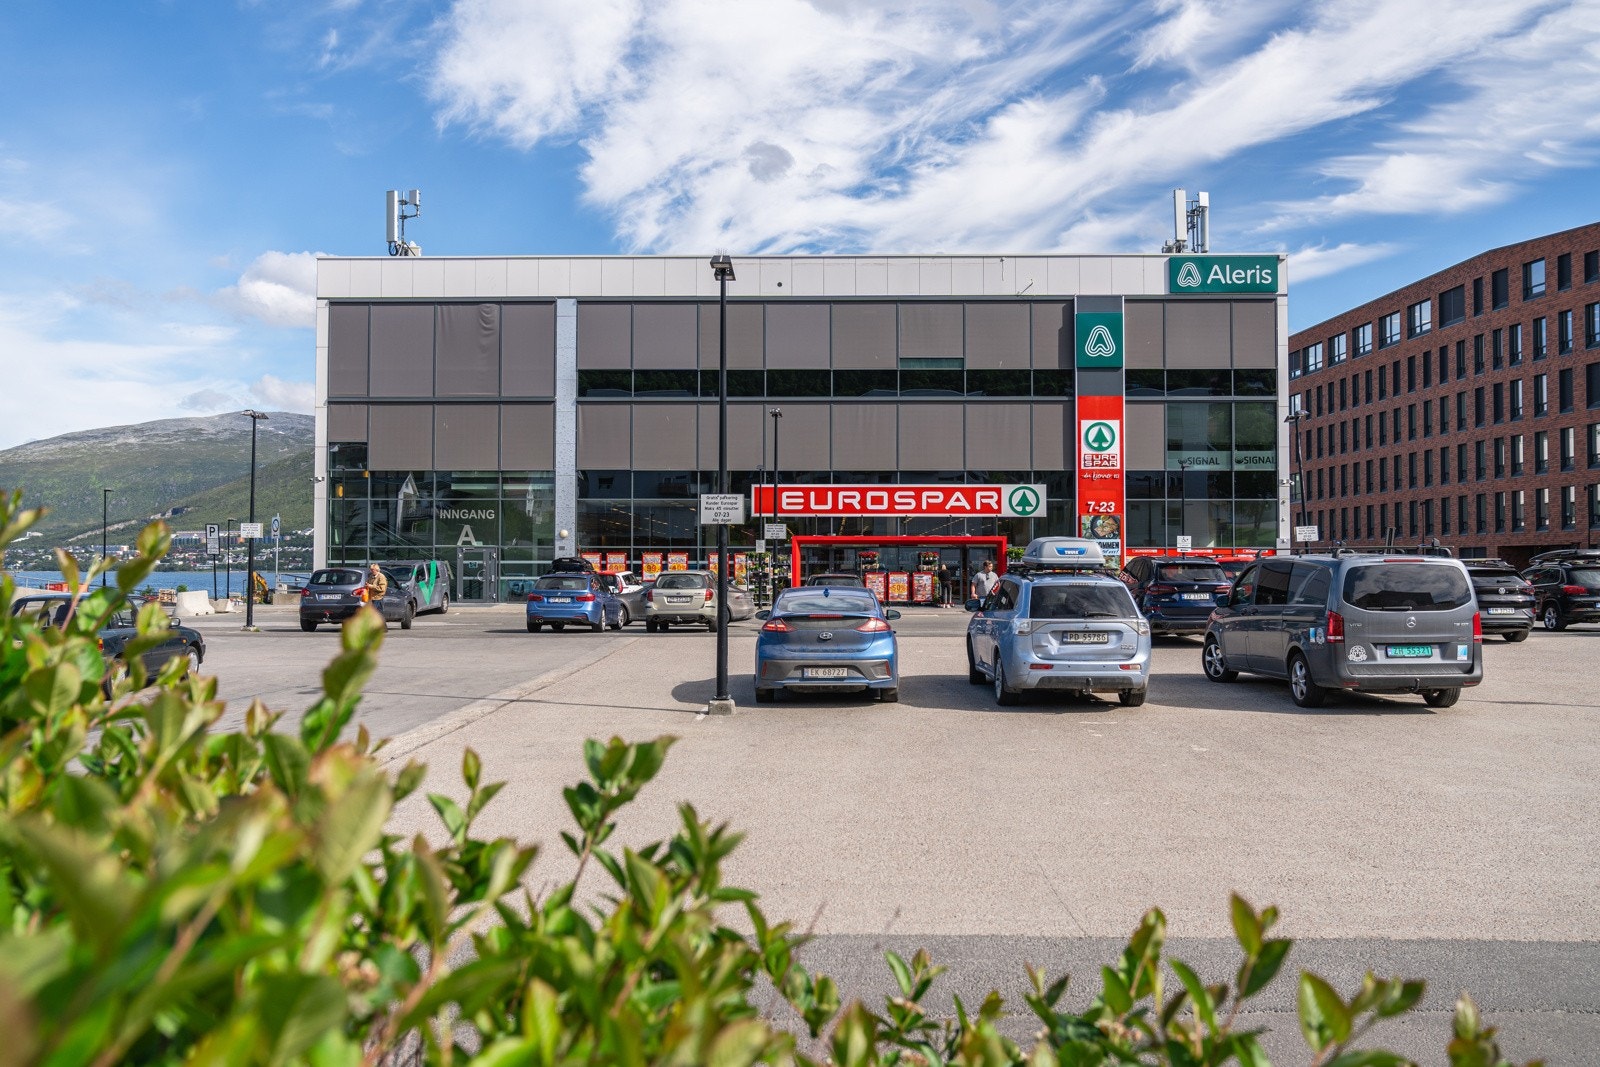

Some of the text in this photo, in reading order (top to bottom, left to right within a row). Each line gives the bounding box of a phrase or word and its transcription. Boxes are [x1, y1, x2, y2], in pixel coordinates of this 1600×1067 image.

[1206, 264, 1272, 284] Aleris
[1187, 456, 1220, 466] SIGNAL
[781, 491, 999, 510] EUROSPAR
[1087, 502, 1116, 512] 7-23
[440, 509, 496, 520] INNGANG
[210, 526, 216, 537] P
[456, 524, 476, 546] A
[1082, 633, 1107, 641] 55786
[1394, 646, 1432, 654] ZH 55321
